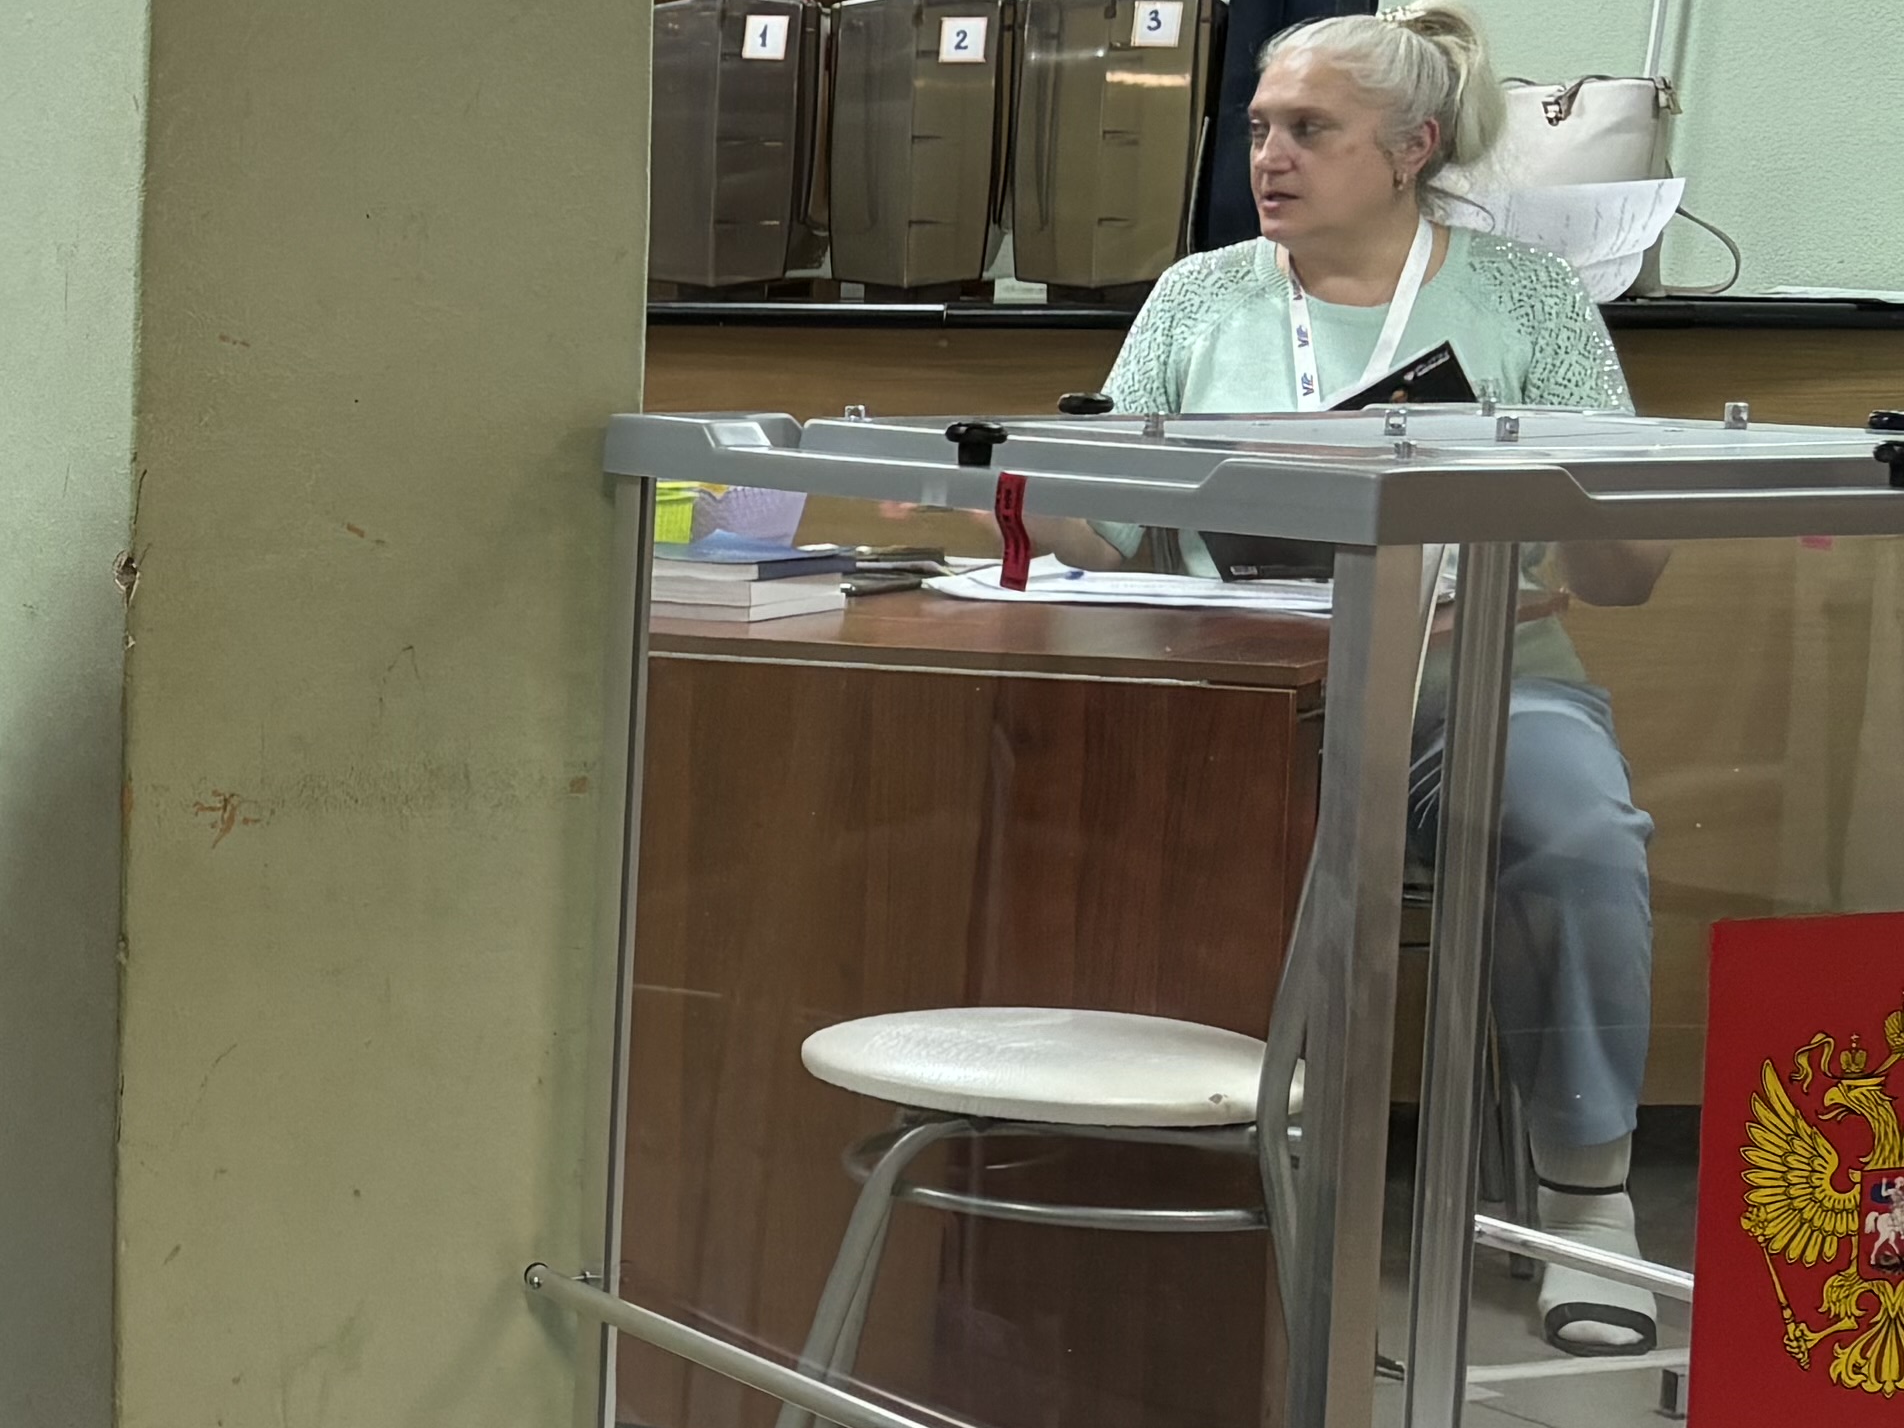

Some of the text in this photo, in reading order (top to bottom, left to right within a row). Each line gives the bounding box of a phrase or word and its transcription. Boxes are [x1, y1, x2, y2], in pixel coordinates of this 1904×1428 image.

[1146, 10, 1161, 31] 3
[758, 25, 768, 47] 1
[955, 29, 969, 51] 2
